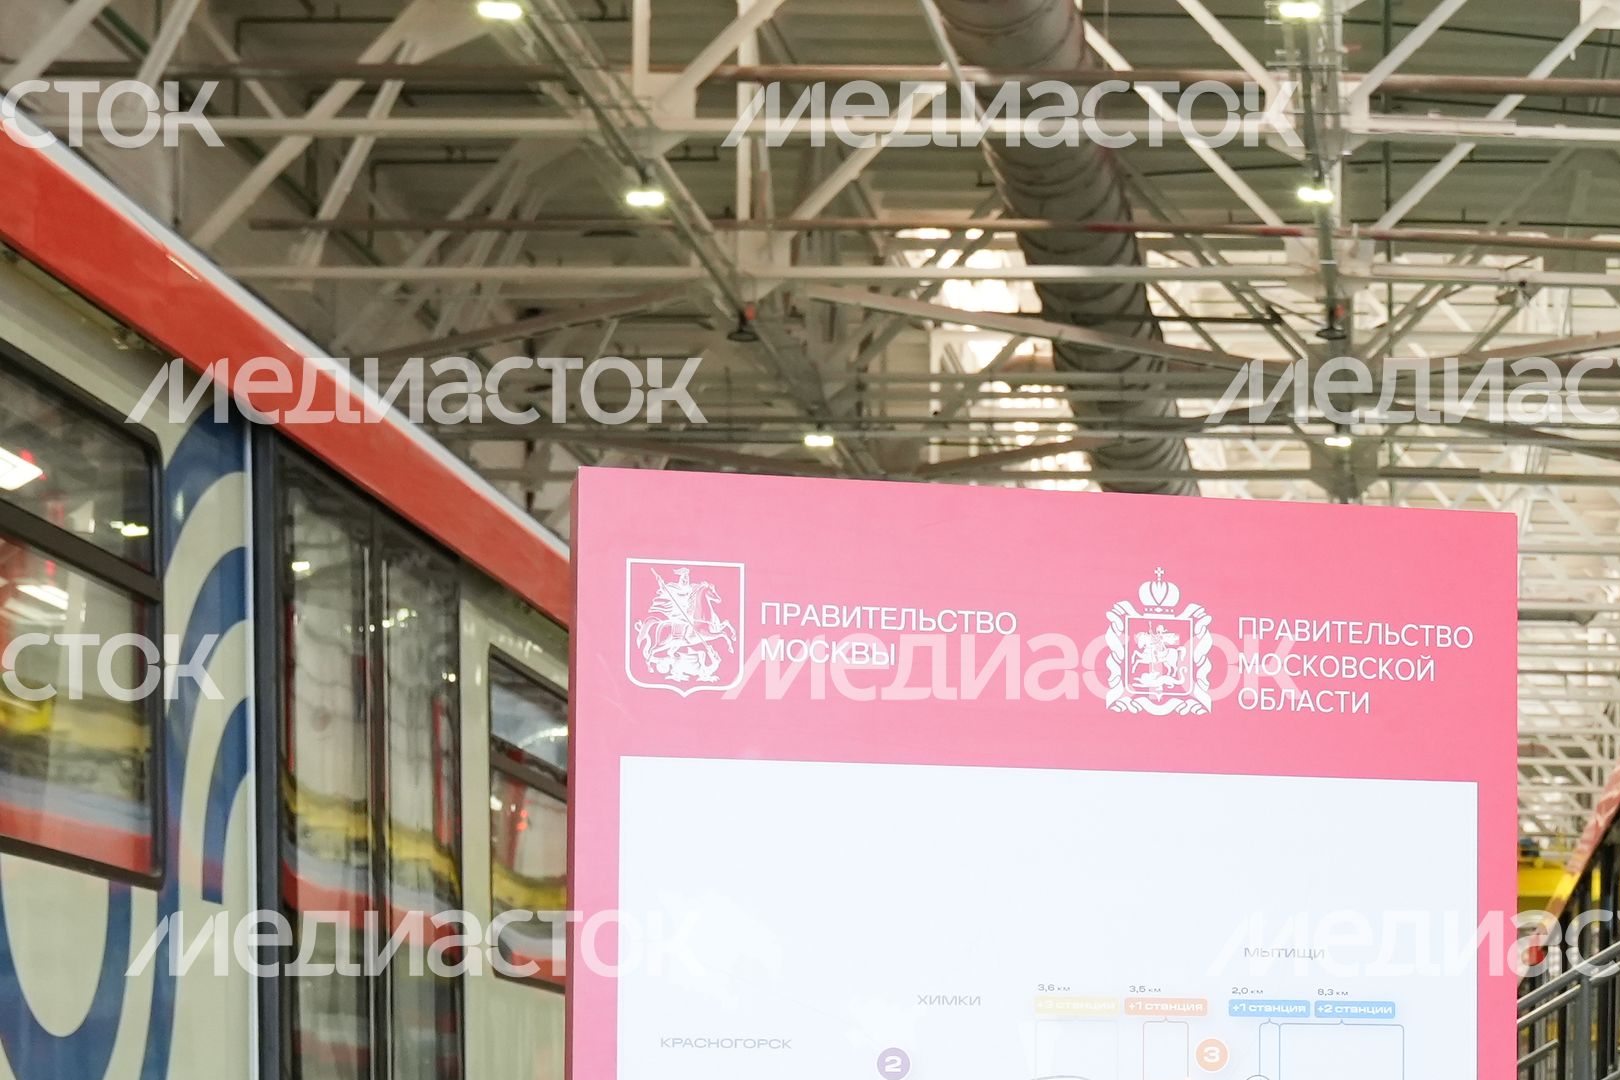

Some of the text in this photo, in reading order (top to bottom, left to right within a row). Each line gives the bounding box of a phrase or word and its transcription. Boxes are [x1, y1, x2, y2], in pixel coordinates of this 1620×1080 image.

[760, 600, 1018, 633] ПРАВИТЕЛЬСТВО
[1237, 615, 1474, 650] ПРАВИТЕЛЬСТВО
[760, 636, 897, 667] МОСКВЫ
[1237, 649, 1436, 683] МОСКОВСКОЙ
[1237, 685, 1371, 714] ОБЛАСТИ
[1243, 946, 1325, 961] МЫТИЩИ
[917, 994, 981, 1006] ХИМКИ
[1128, 1002, 1203, 1013] +1 станция
[1232, 1003, 1306, 1014] +1 станция
[1317, 1004, 1392, 1015] +2 станции
[660, 1037, 792, 1050] КРАСНОГОРСК
[1203, 1046, 1221, 1063] 3
[884, 1055, 902, 1072] 2
